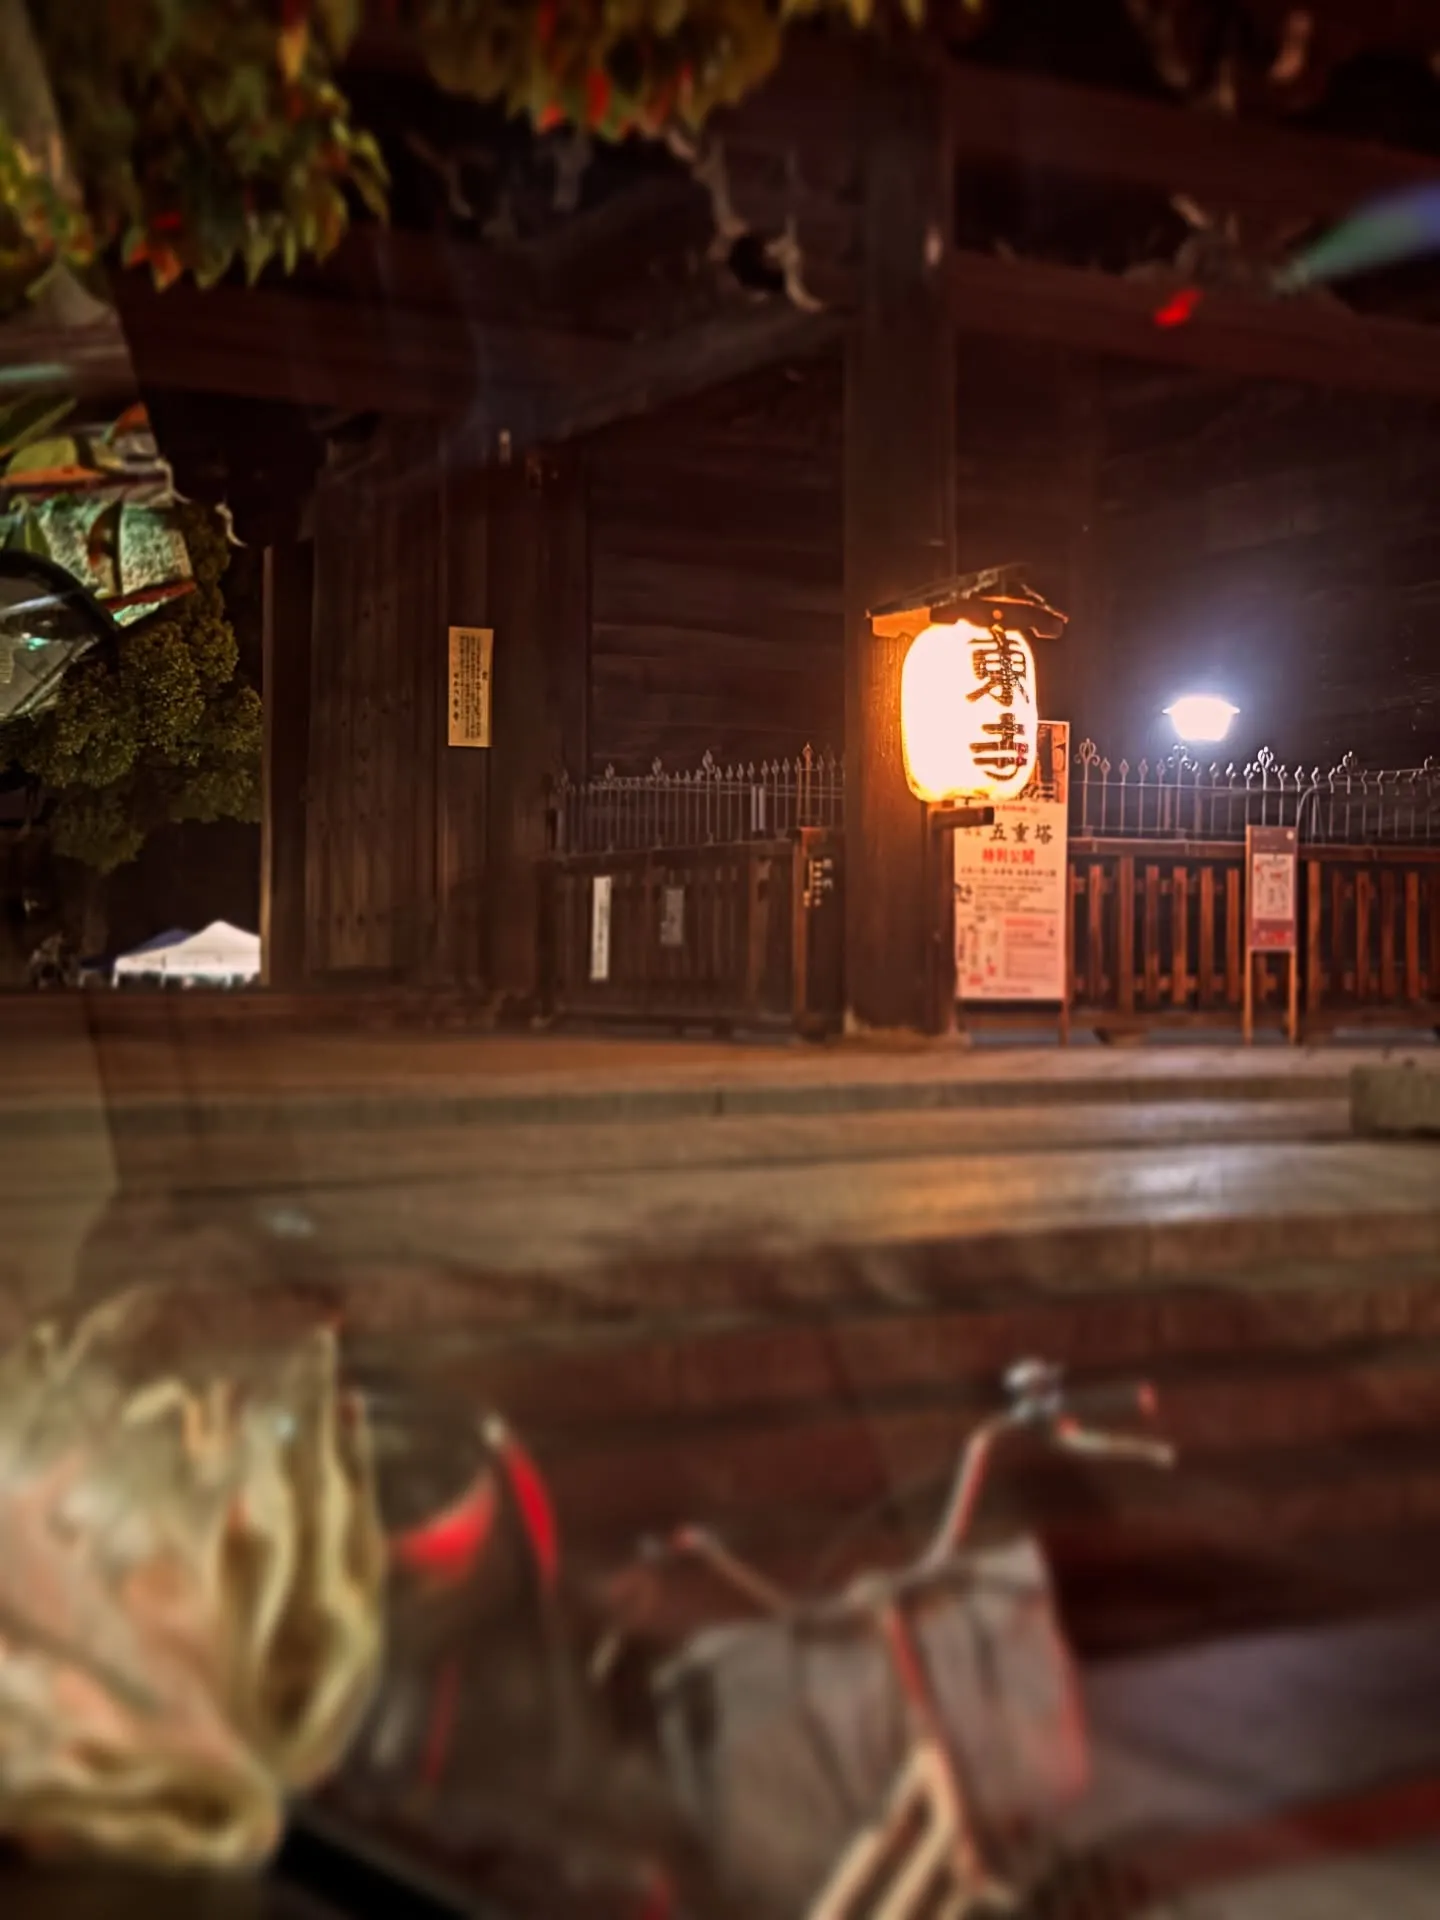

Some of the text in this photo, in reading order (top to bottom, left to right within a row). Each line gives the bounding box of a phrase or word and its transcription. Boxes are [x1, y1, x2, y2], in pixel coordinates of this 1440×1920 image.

[966, 626, 1029, 781] 東寺
[989, 822, 1053, 845] 五重塔
